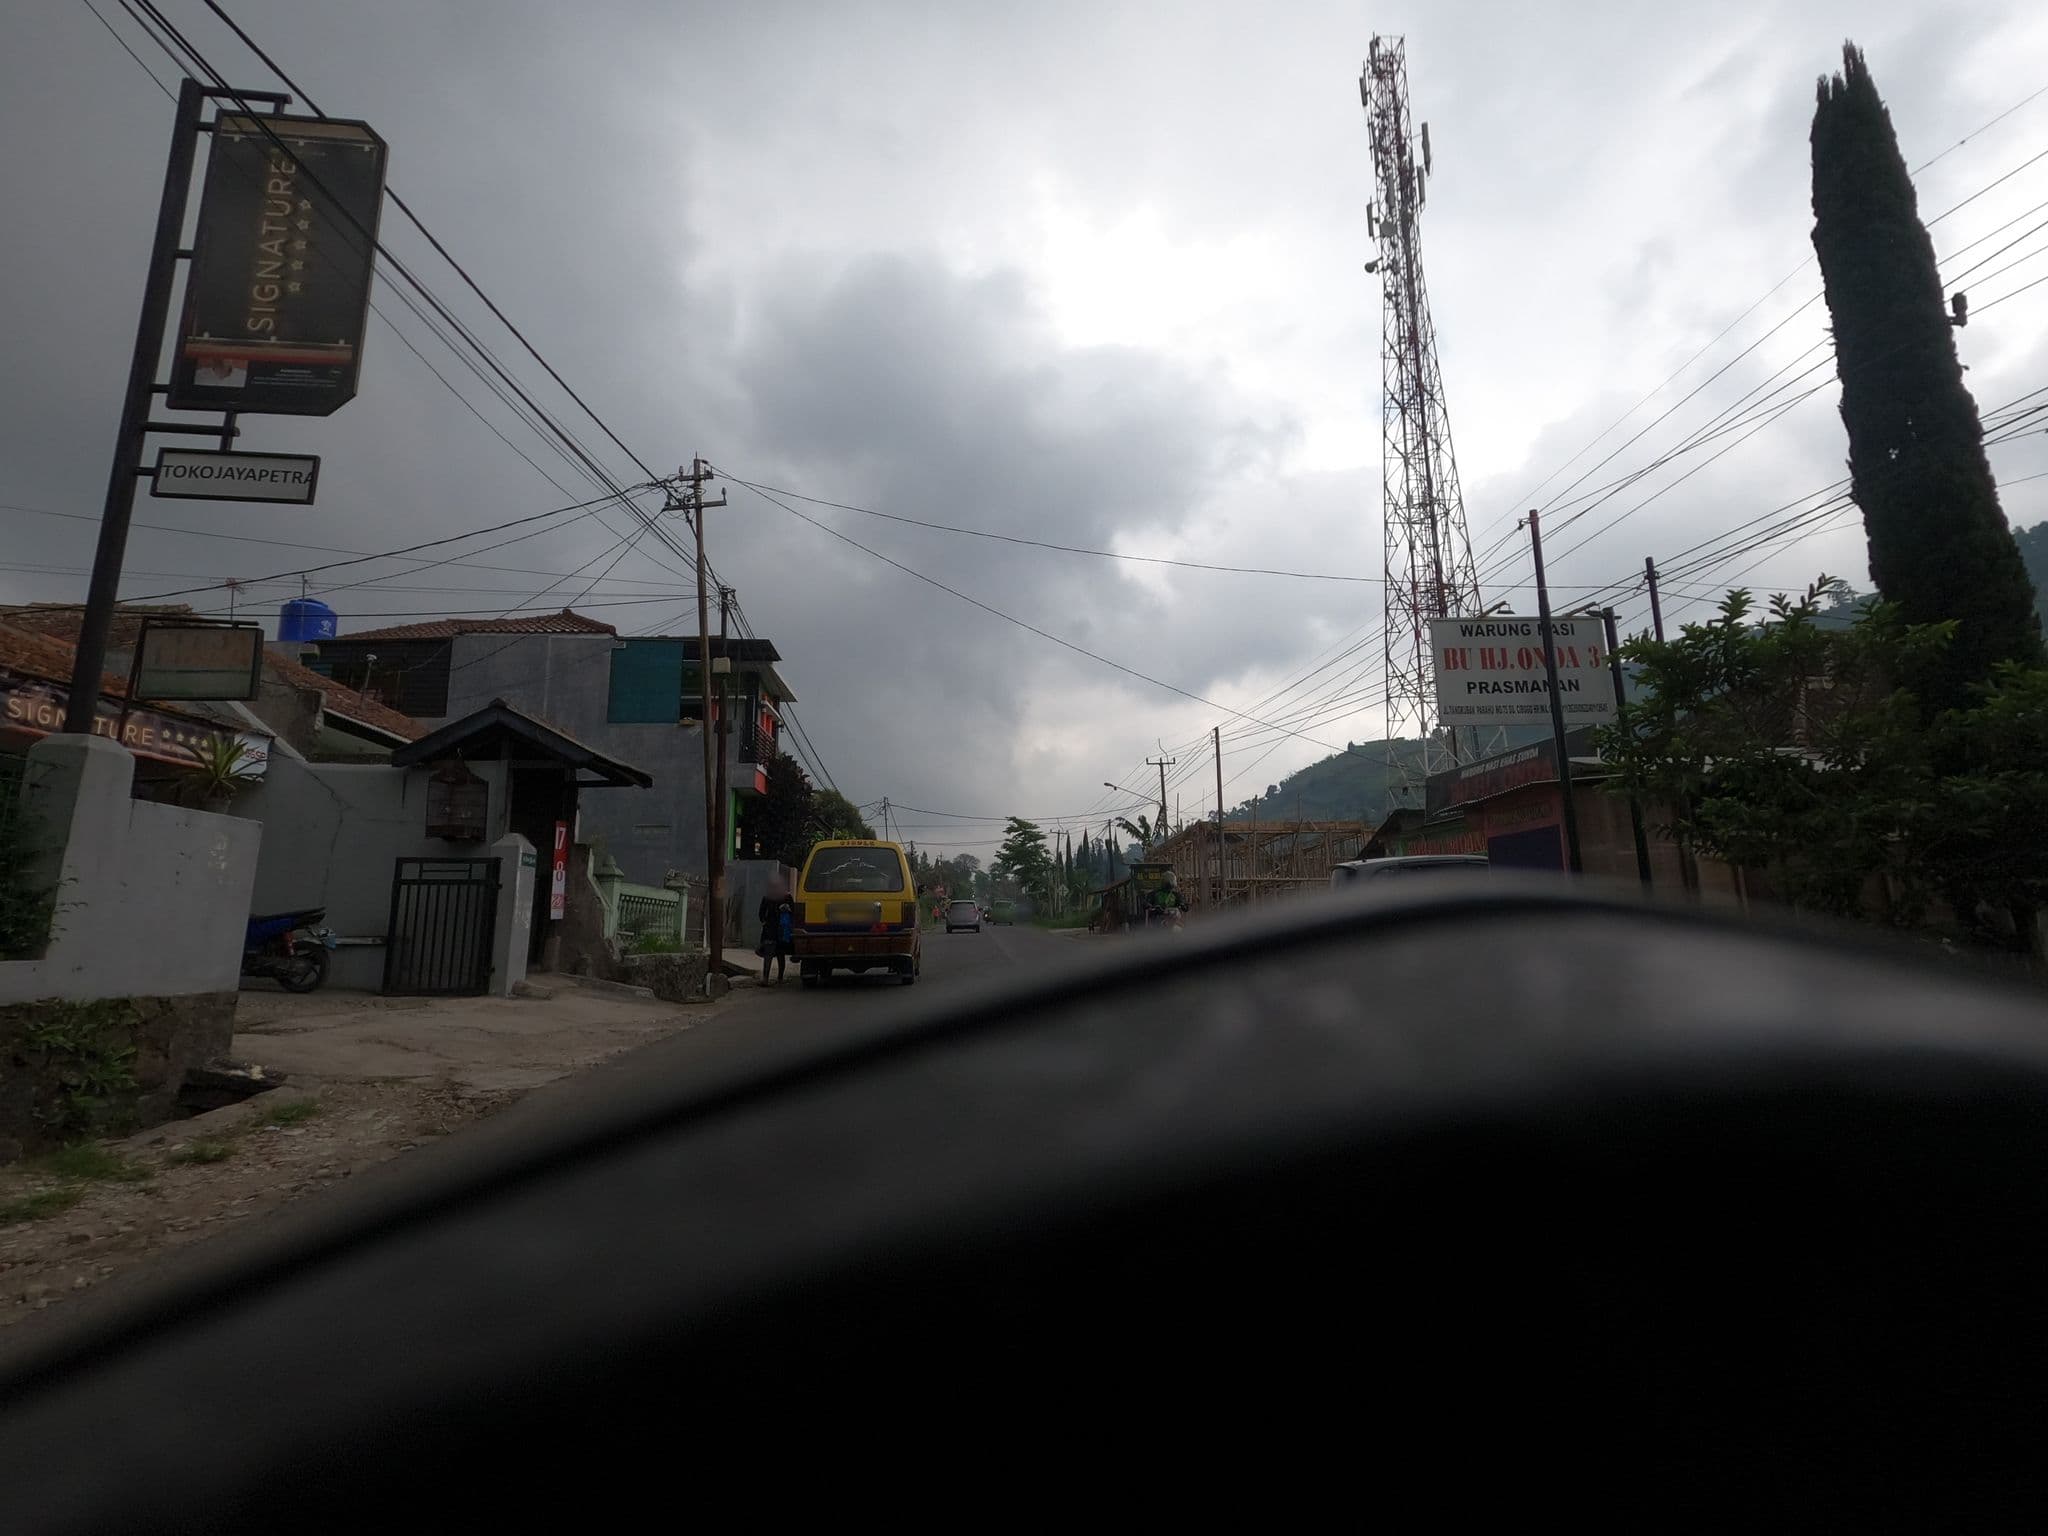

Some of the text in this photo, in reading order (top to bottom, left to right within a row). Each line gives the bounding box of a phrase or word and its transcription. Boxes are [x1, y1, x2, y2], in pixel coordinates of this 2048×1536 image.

[247, 159, 297, 332] SIGNATURE
[1460, 623, 1531, 637] WARUNG
[1443, 647, 1472, 671] BU
[1588, 646, 1601, 669] 3
[7, 699, 154, 746] SIGNTURE
[555, 827, 567, 850] 17
